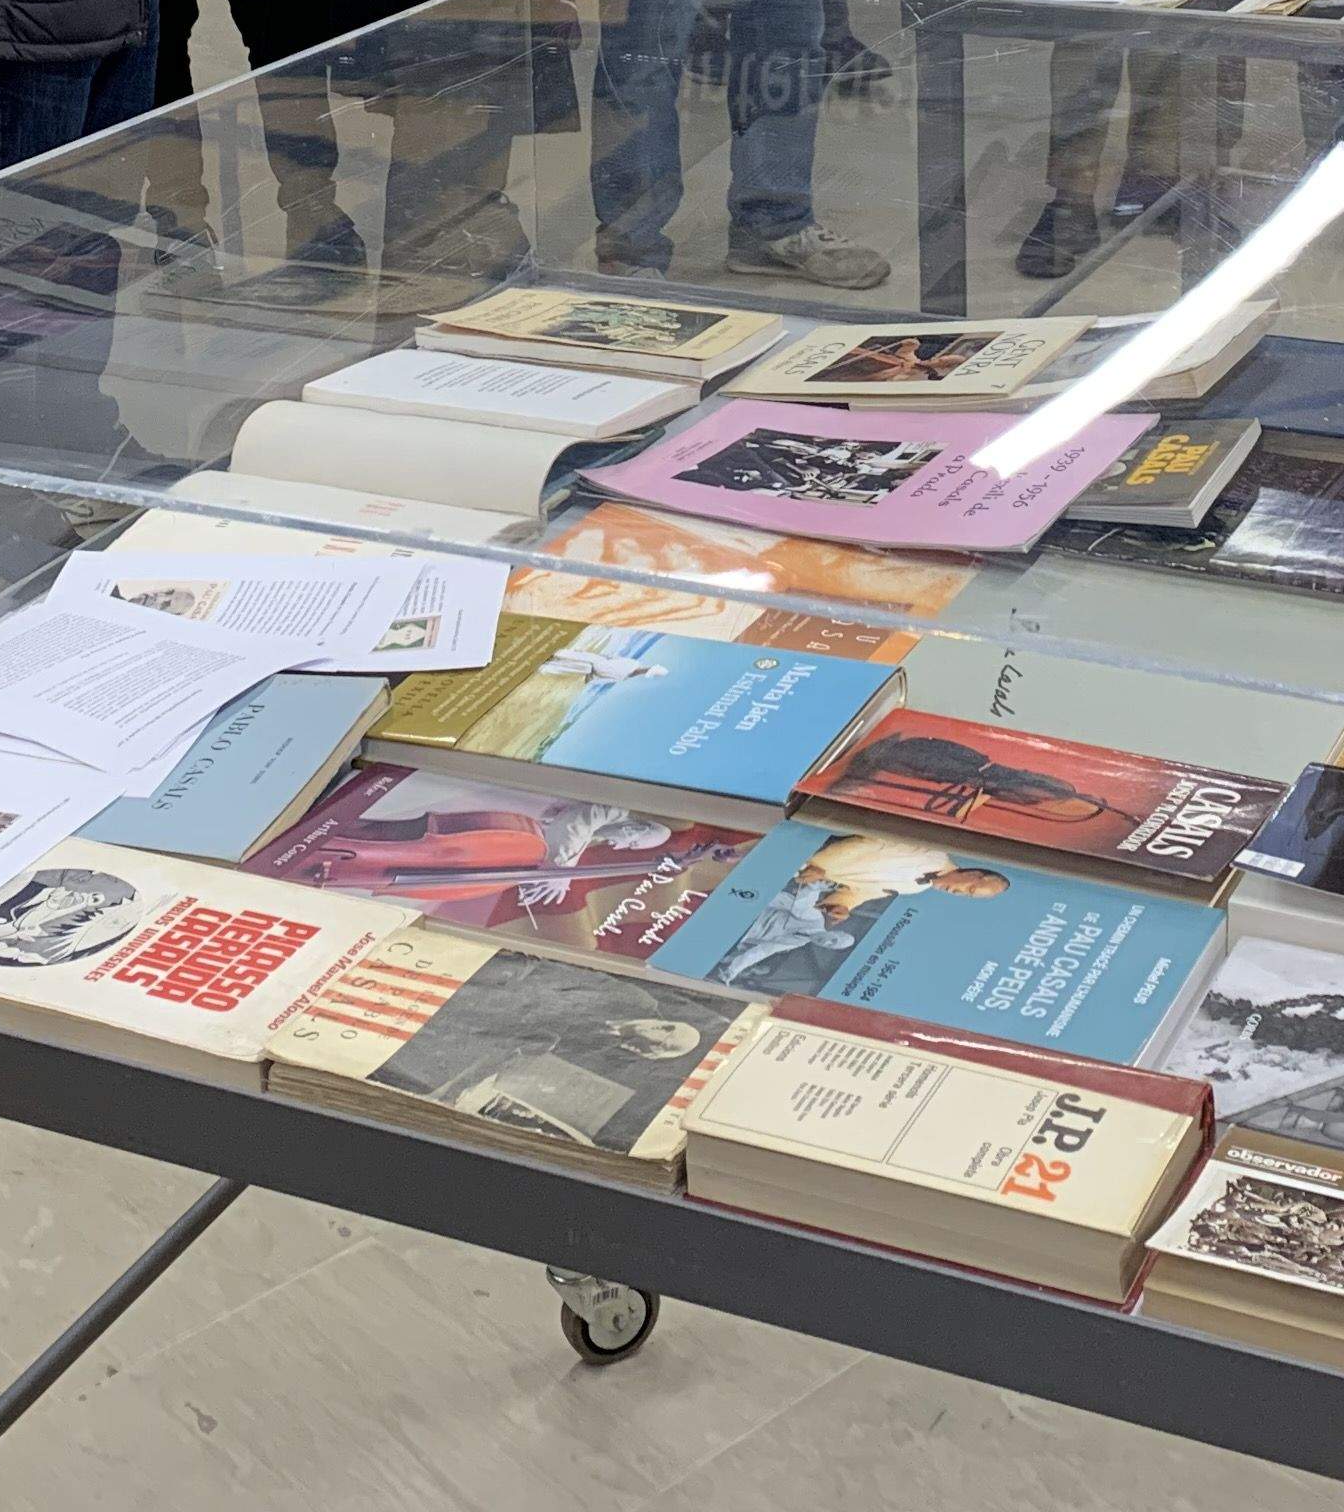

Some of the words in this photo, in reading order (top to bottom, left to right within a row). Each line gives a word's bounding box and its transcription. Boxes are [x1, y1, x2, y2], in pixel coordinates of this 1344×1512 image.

[779, 342, 850, 375] CASALS
[952, 333, 1026, 376] NOSTRA
[989, 339, 1049, 368] GENT
[1046, 446, 1090, 471] 1939
[1123, 431, 1191, 488] CASALS
[1162, 441, 1209, 475] PAU
[904, 463, 965, 499] Prada
[931, 469, 995, 508] Casals
[1005, 481, 1053, 509] 1956
[956, 501, 993, 518] de
[702, 671, 767, 718] Estimat
[760, 662, 817, 701] Maria
[206, 703, 269, 751] PABLO
[727, 700, 780, 732] Jaén
[663, 718, 720, 757] Pablo
[146, 757, 218, 811] CASALS
[299, 817, 343, 844] Arthur
[1115, 811, 1170, 852] CORREDOR
[1140, 784, 1246, 860] CASALS
[270, 843, 312, 867] Conte
[628, 872, 672, 898] Pau
[673, 888, 708, 905] La
[149, 895, 202, 926] PABLOS
[587, 896, 650, 939] Casals
[624, 901, 697, 947] légende
[1125, 903, 1146, 917] UN
[110, 906, 241, 987] CASALS
[871, 916, 912, 955] Roussillon
[1012, 912, 1072, 967] ANDRÉ
[1060, 922, 1103, 956] PAU
[1103, 914, 1138, 947] CHEMIN
[186, 919, 322, 1014] PICASSO
[863, 954, 882, 965] en
[971, 959, 999, 983] MON
[1089, 945, 1119, 969] TRACÉ
[1144, 956, 1174, 984] Michel
[289, 940, 417, 1043] CASALS
[302, 956, 355, 994] Manuel
[838, 964, 874, 997] musique
[974, 965, 1036, 1015] PEUS,
[1018, 954, 1083, 1019] CASALS
[1079, 967, 1102, 984] PAR
[1044, 983, 1093, 1038] L'HUMANISME
[1131, 982, 1156, 1005] PEUS
[261, 992, 317, 1032] Alonso
[772, 1033, 808, 1063] Edicions
[889, 1060, 924, 1090] Tercera
[1021, 1090, 1050, 1113] Josep
[1015, 1112, 1034, 1126] Pla
[1028, 1091, 1111, 1155] J.P.
[958, 1141, 997, 1179] completa
[988, 1146, 1015, 1168] Obra
[1227, 1149, 1342, 1182] observador
[997, 1151, 1076, 1207] 21
